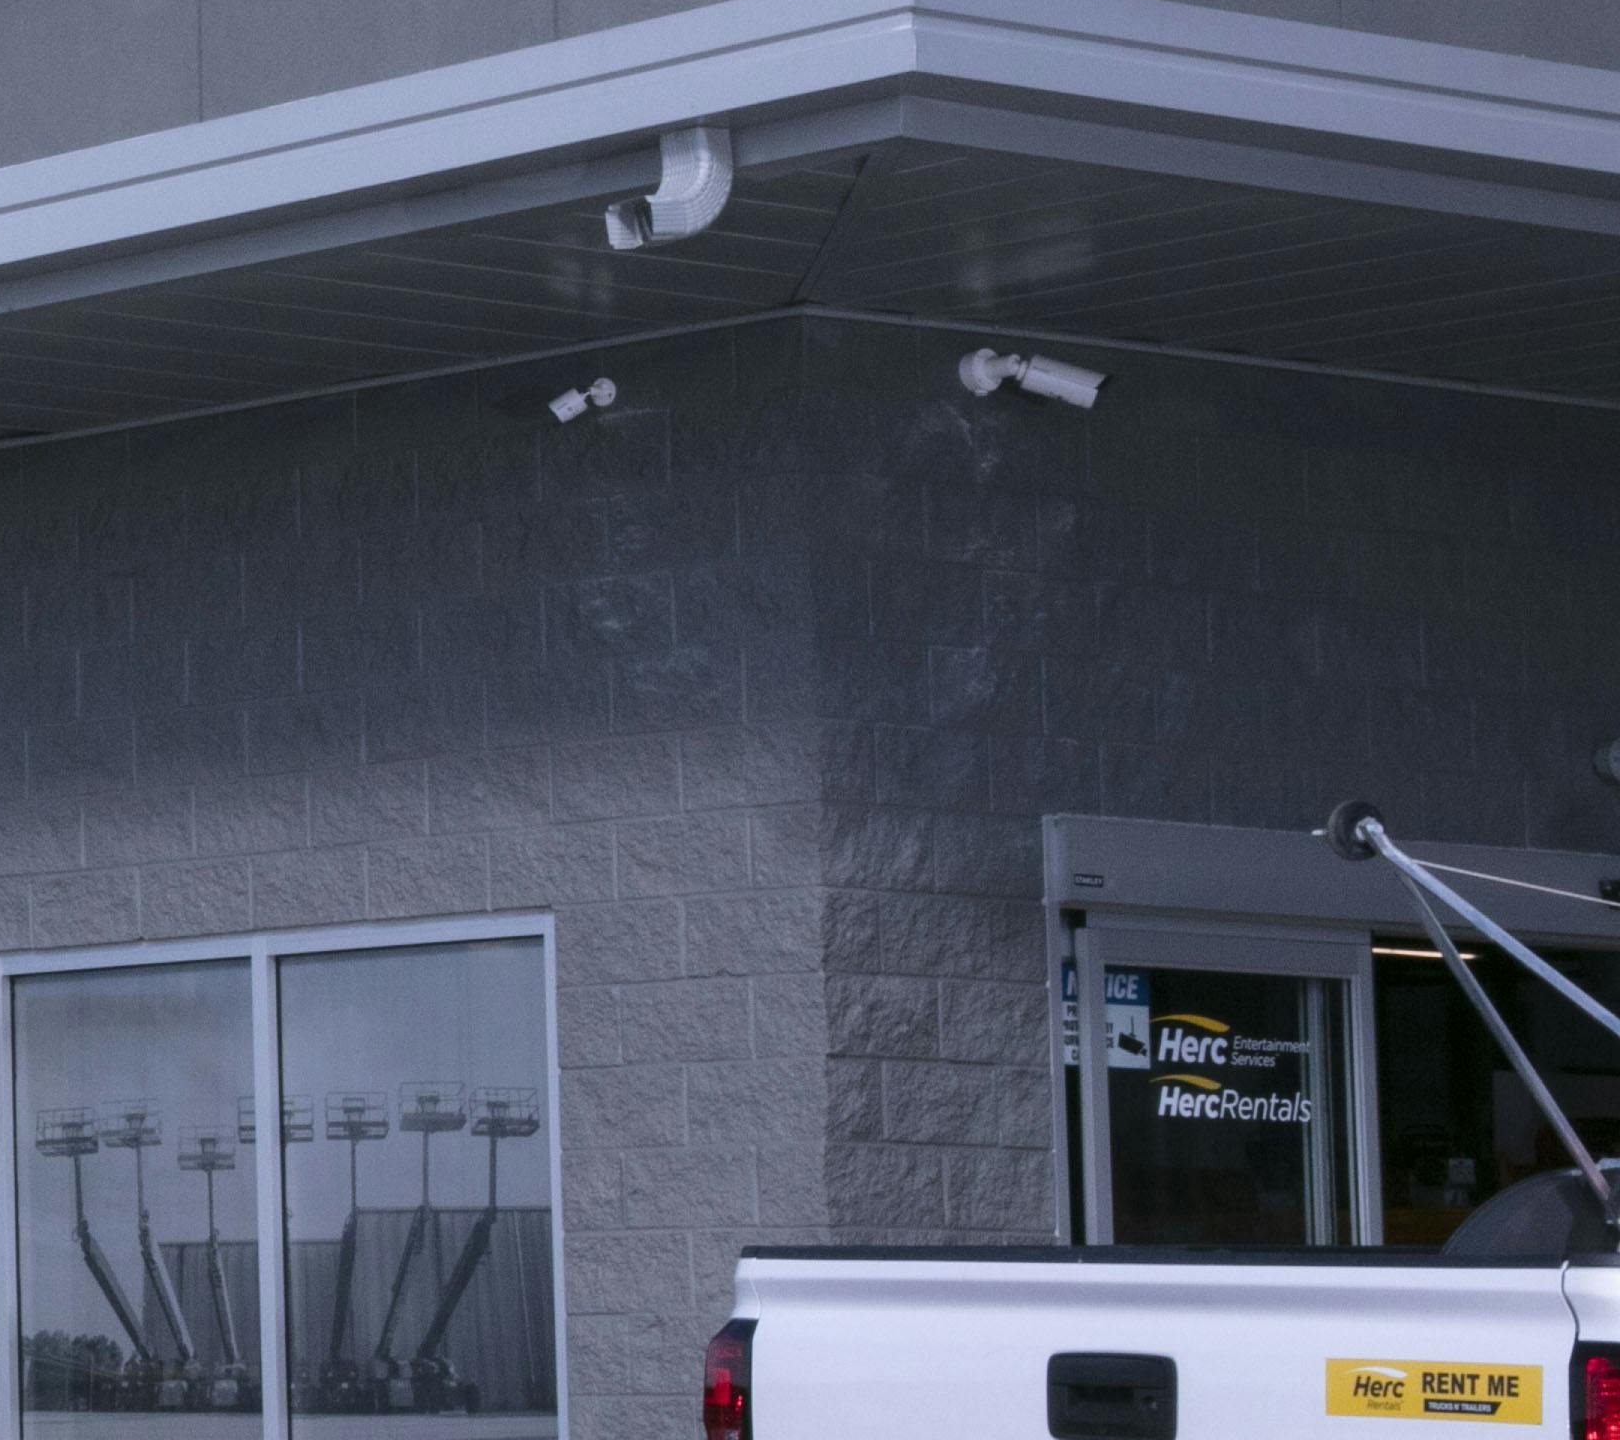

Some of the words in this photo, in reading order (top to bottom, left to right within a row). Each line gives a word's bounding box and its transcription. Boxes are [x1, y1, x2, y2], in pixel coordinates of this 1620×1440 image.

[1158, 1027, 1228, 1065] Herc
[1232, 1036, 1310, 1054] Entertainment
[1230, 1052, 1276, 1068] Services
[1158, 1085, 1312, 1123] HercRentals
[1353, 1375, 1406, 1398] Herc
[1421, 1372, 1480, 1396] RENT
[1487, 1375, 1520, 1398] ME
[1366, 1399, 1402, 1411] Rentals
[1461, 1402, 1493, 1413] TRAILERS
